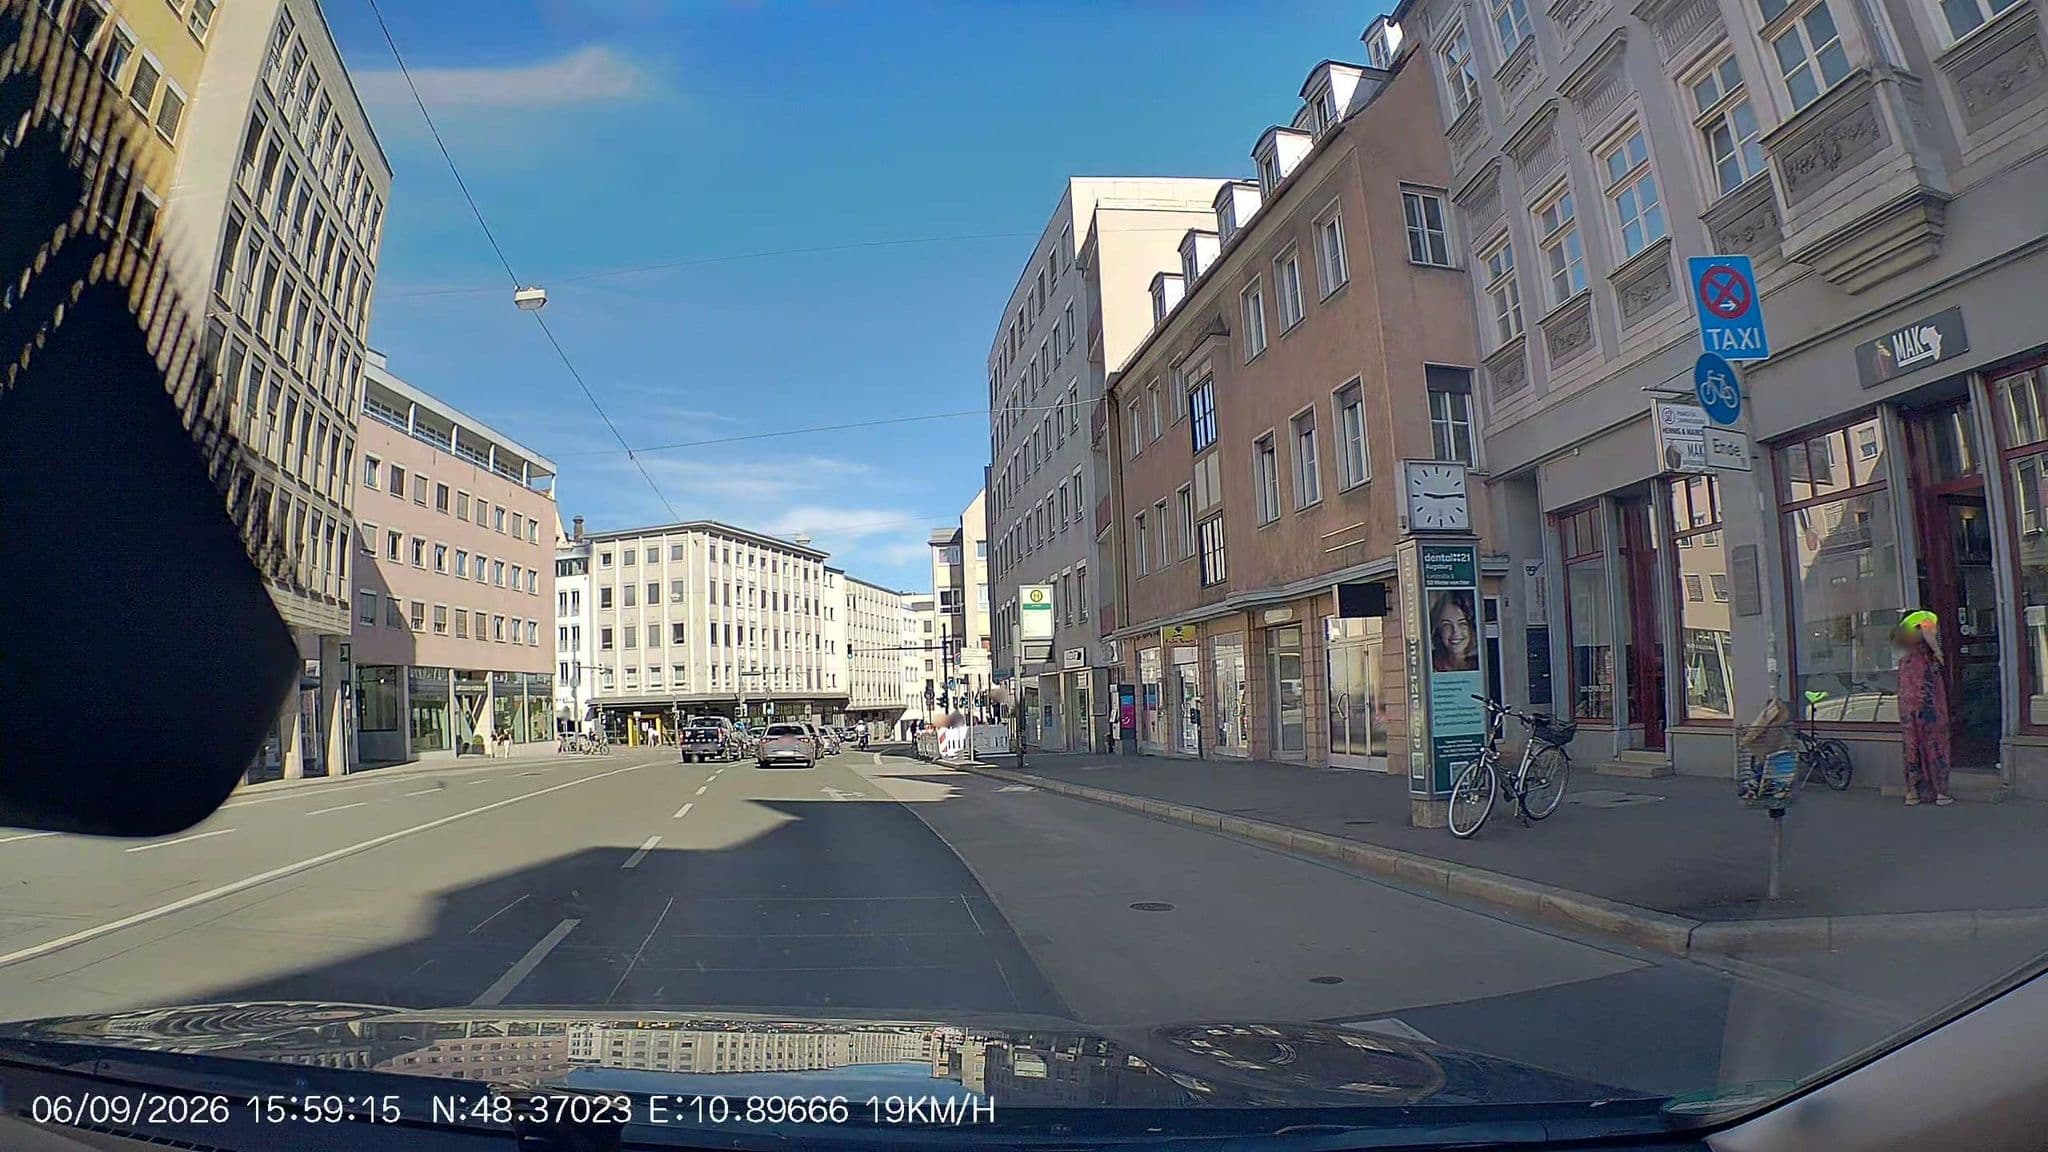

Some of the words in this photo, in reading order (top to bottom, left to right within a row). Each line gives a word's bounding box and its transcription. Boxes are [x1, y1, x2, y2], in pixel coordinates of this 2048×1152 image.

[1706, 327, 1761, 351] TAXI
[1892, 325, 1924, 361] MAK
[1712, 438, 1742, 458] Ende
